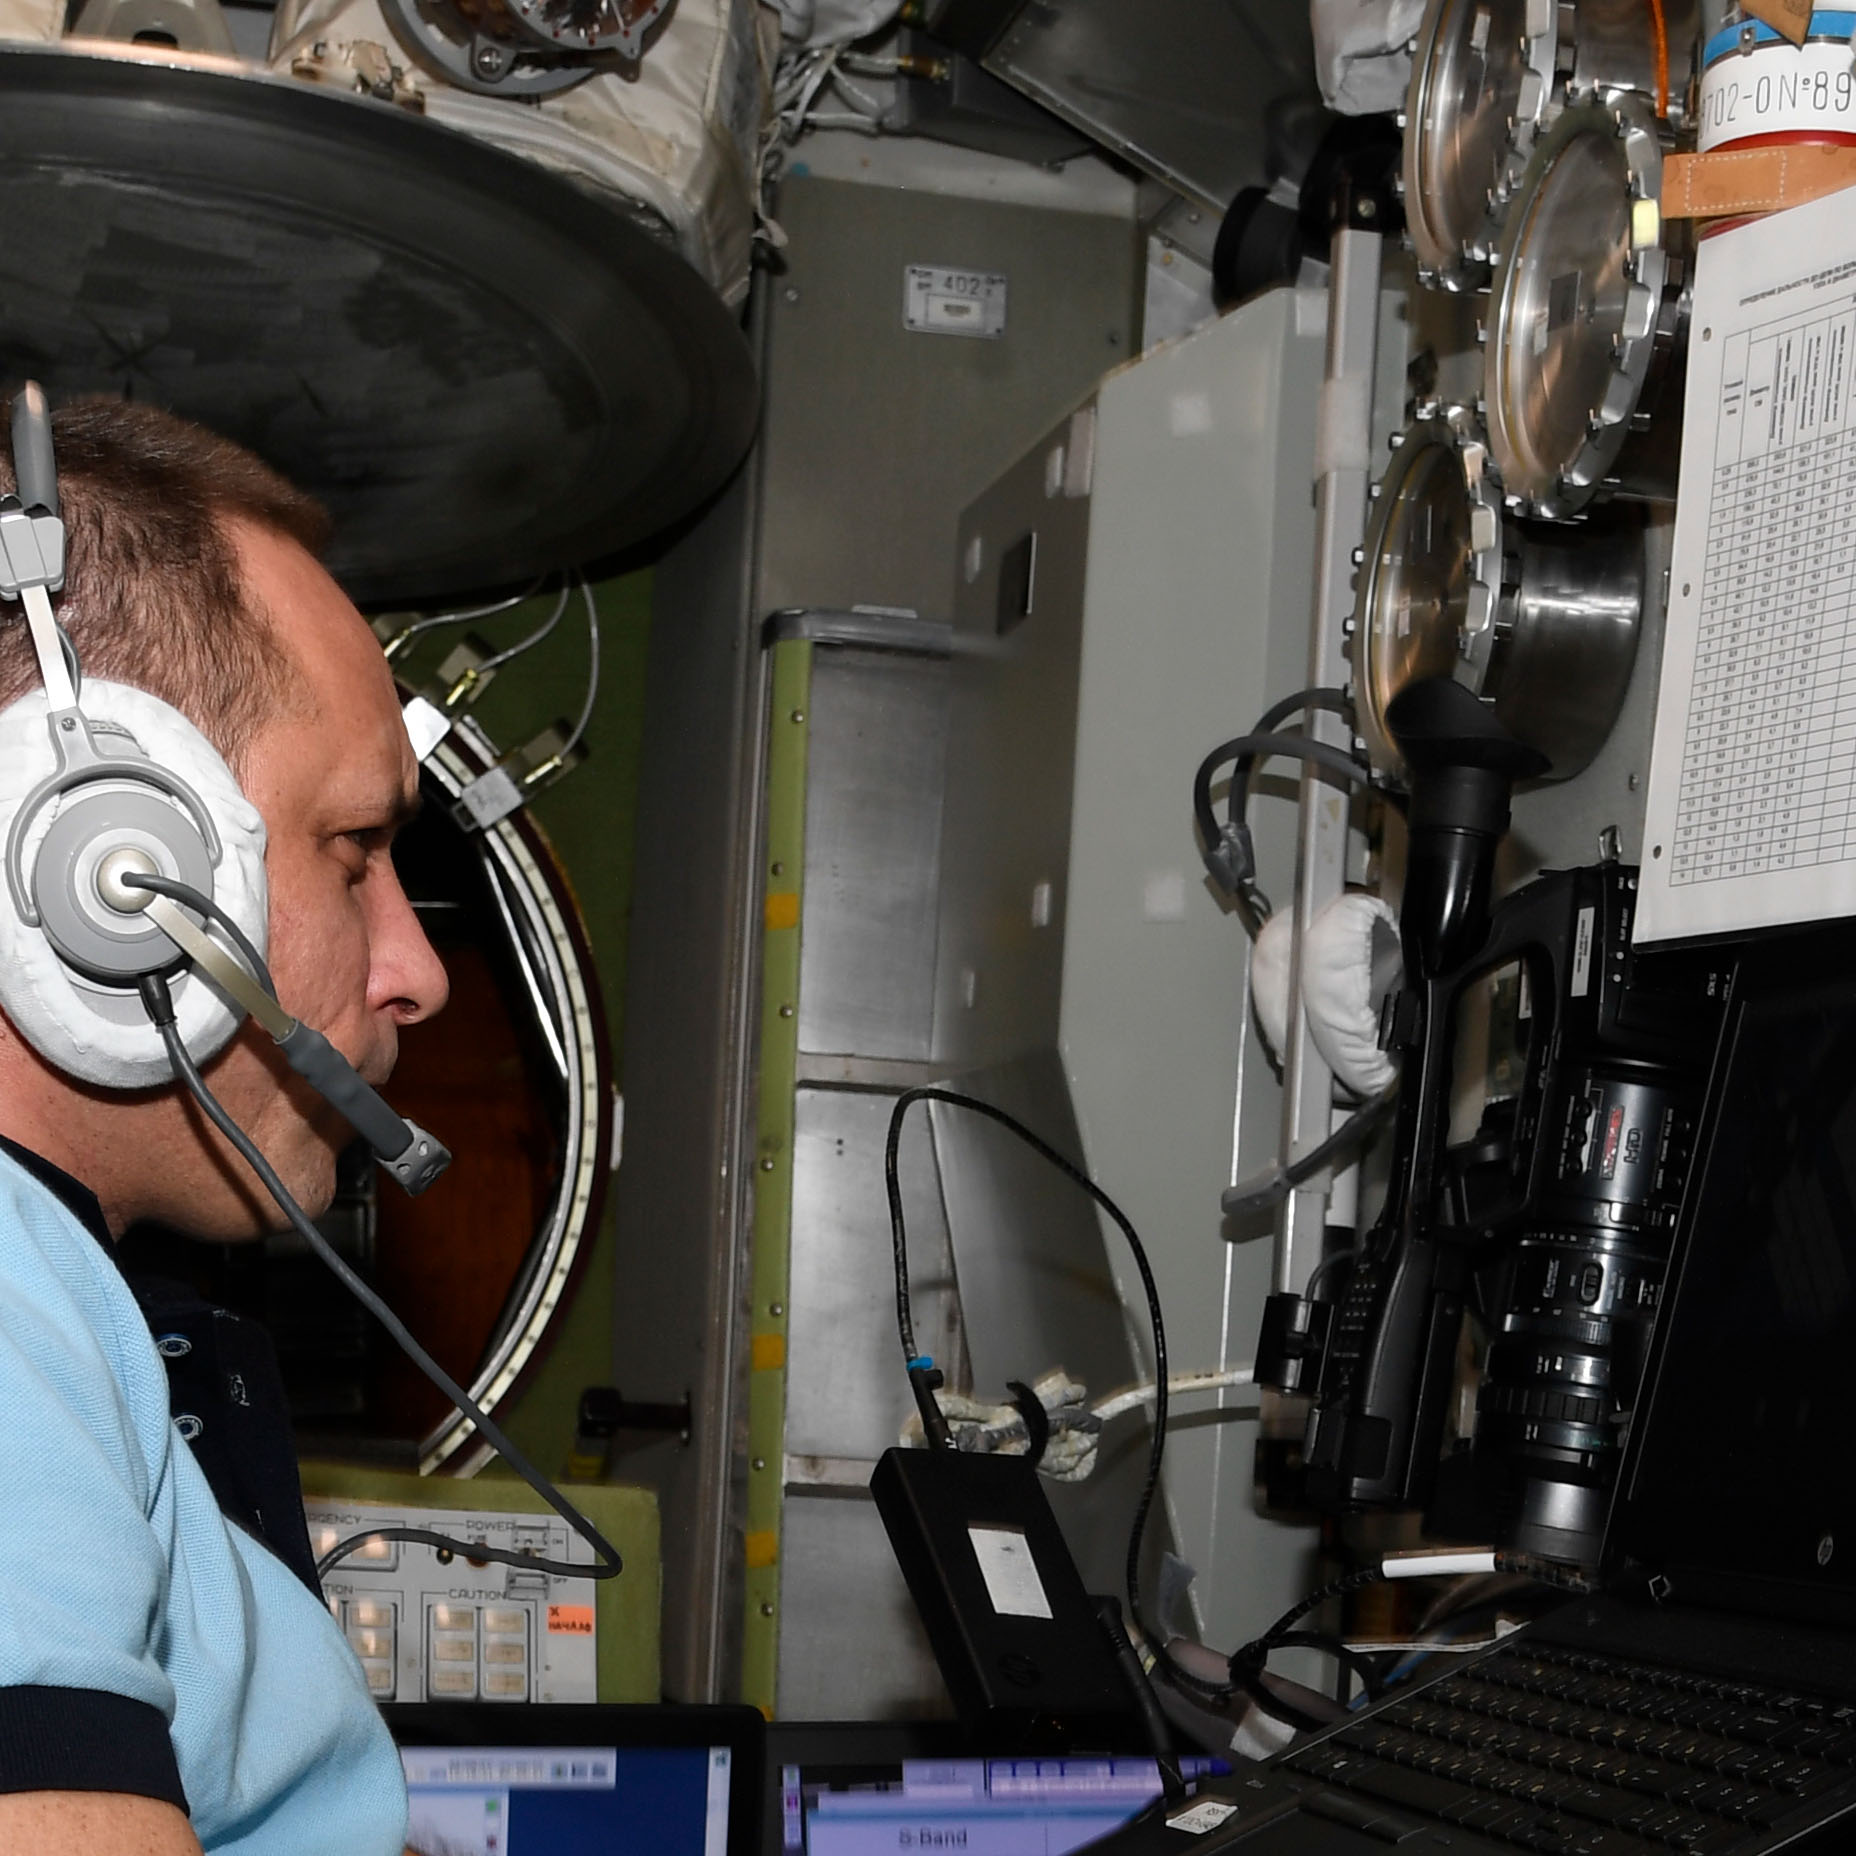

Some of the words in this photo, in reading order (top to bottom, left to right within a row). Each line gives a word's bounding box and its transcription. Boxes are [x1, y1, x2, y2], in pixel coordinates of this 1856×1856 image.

[1700, 80, 1771, 140] 702-0
[944, 275, 980, 295] 402
[307, 1513, 362, 1526] RGENCY
[465, 1519, 514, 1532] POWER
[448, 1588, 507, 1601] CAUTION
[899, 1828, 968, 1849] S-Band
